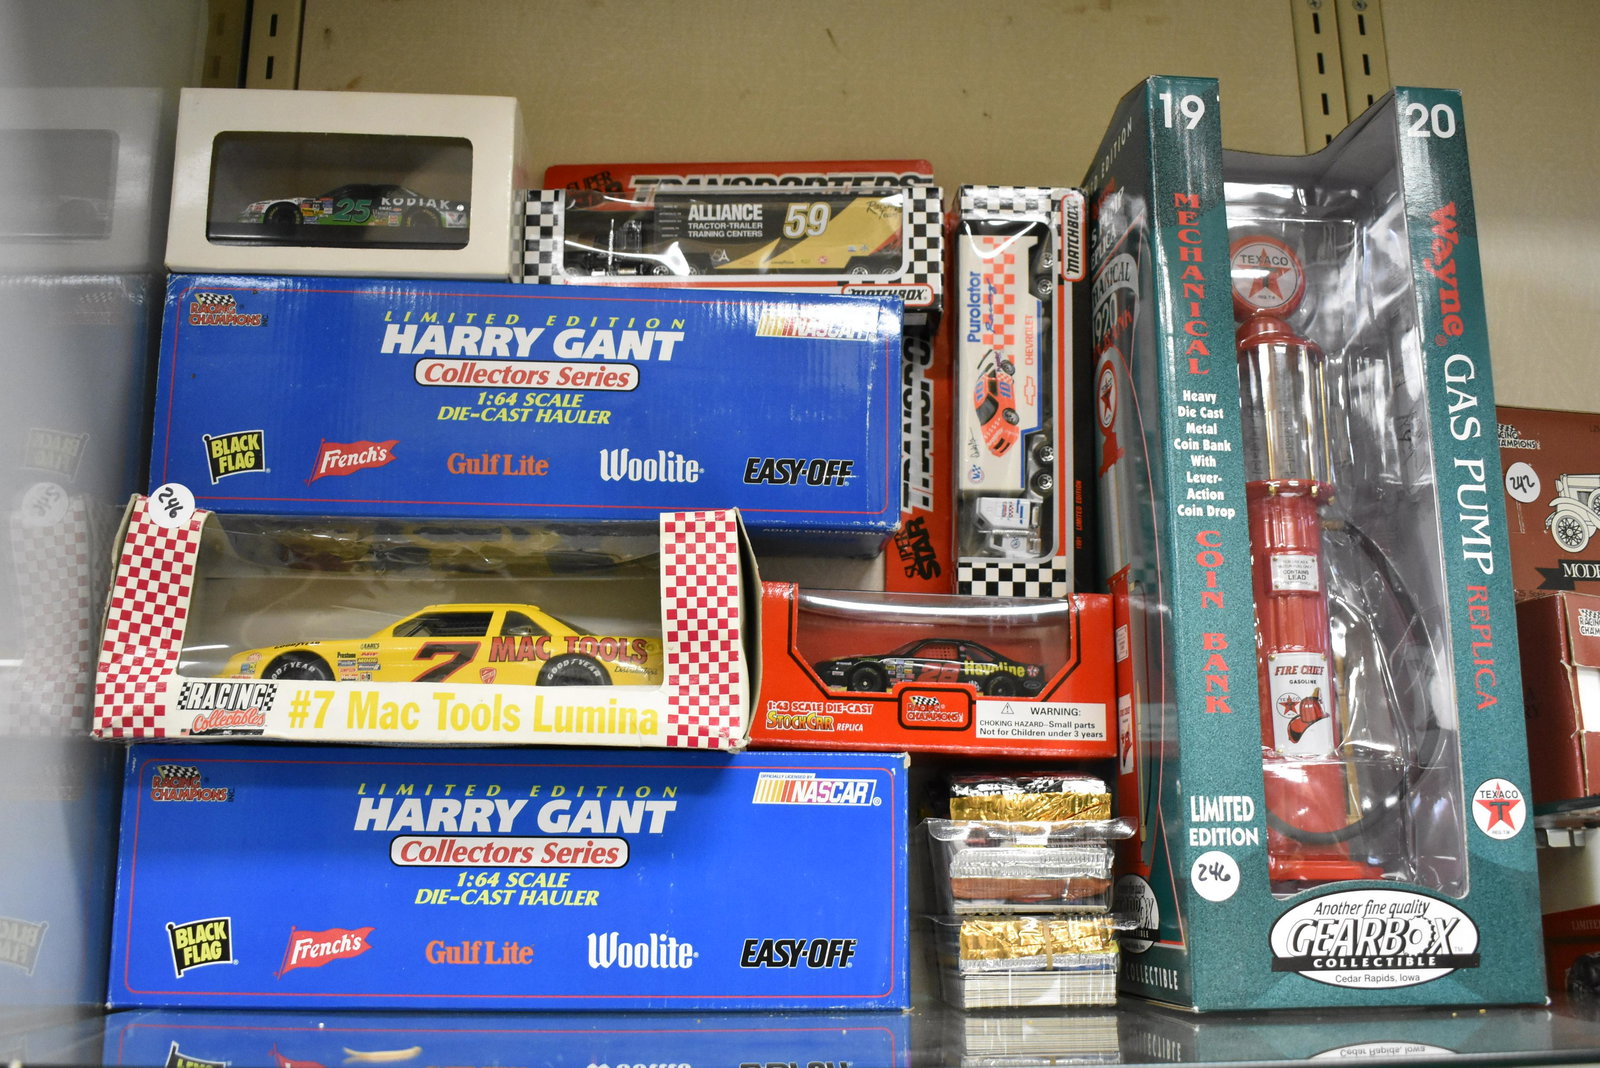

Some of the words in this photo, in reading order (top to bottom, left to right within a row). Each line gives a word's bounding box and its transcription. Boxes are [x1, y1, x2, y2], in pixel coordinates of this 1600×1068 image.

[1158, 92, 1206, 130] 19
[1404, 102, 1457, 139] 20
[333, 199, 372, 223] 25
[381, 196, 450, 210] KODIAK
[687, 203, 763, 221] ALLIANCE
[687, 222, 763, 230] TRACTOR-TRAILER
[783, 201, 832, 239] 59
[687, 230, 726, 238] TRAINING
[726, 230, 763, 238] CENTERS
[1066, 201, 1080, 274] MATCHBOX
[1240, 254, 1289, 266] TEXACO
[1423, 201, 1465, 337] Wayne
[1173, 192, 1211, 375] MECHANICAL
[190, 302, 237, 314] RACING
[967, 271, 982, 343] Purolator
[189, 313, 262, 326] CHAMPIONS
[384, 310, 520, 325] LIMITED
[546, 314, 687, 330] EDITION
[380, 323, 546, 357] HARRY
[553, 327, 685, 361] GANT
[1024, 315, 1034, 366] CHEVROLET
[424, 362, 550, 385] Collectors
[556, 366, 631, 388] Series
[477, 391, 517, 405] 1:64
[523, 393, 584, 408] SCALE
[1183, 390, 1217, 404] Heavy
[1444, 353, 1482, 441] GAS
[437, 406, 532, 422] DIE-CAST
[535, 409, 612, 424] HAULER
[1177, 406, 1197, 417] Die
[1200, 407, 1224, 419] Cast
[1186, 422, 1217, 435] Metal
[211, 433, 261, 460] BLACK
[1174, 438, 1200, 450] Coin
[1203, 439, 1231, 451] Bank
[1498, 439, 1538, 449] AMPIONS
[218, 450, 255, 474] FLAG
[319, 444, 388, 474] French's
[447, 453, 499, 475] Gulf
[507, 454, 549, 477] Lite
[599, 448, 700, 483] Woolite
[1191, 455, 1216, 467] With
[743, 457, 855, 487] EASY-OFF
[1186, 471, 1222, 484] Lever-
[157, 486, 185, 520] 246
[1187, 488, 1224, 501] Action
[1177, 504, 1203, 517] Coin
[1206, 506, 1235, 520] Drop
[1454, 457, 1494, 575] PUMP
[1195, 529, 1225, 609] COIN
[488, 636, 552, 663] MAC
[564, 635, 649, 665] TOOLS
[1466, 584, 1499, 711] REPLICA
[412, 640, 482, 683] 7
[1201, 632, 1232, 714] BANK
[1274, 665, 1299, 676] FIRE
[1300, 664, 1325, 676] CHIEF
[186, 683, 269, 711] RACING
[767, 700, 790, 712] 1:43
[791, 702, 823, 713] SCALE
[826, 702, 874, 715] DIE-CAST
[906, 703, 940, 712] RACING
[192, 707, 266, 733] Collectables
[288, 690, 336, 730] #7
[347, 691, 420, 731] Mac
[432, 692, 521, 732] Tools
[533, 694, 658, 735] Lumina
[906, 711, 959, 723] CHAMPIONS
[1030, 707, 1081, 717] WARNING:
[836, 722, 864, 732] REPLICA
[997, 728, 1009, 736] for
[1048, 729, 1072, 737] under
[1082, 731, 1104, 739] years
[1074, 721, 1095, 730] parts
[151, 776, 201, 788] RACING
[357, 782, 502, 797] LIMITED
[529, 784, 678, 798] EDITION
[790, 780, 869, 804] NASCAR
[150, 787, 228, 802] CHAMPIONS
[1479, 789, 1519, 800] TEXACO
[354, 797, 529, 832] HARRY
[537, 799, 677, 834] GANT
[1190, 795, 1255, 822] LIMITED
[1189, 827, 1259, 847] EDITION
[400, 838, 534, 864] Collectors
[540, 840, 620, 865] Series
[457, 871, 499, 887] 1:64
[505, 872, 570, 888] SCALE
[1197, 861, 1232, 882] 246
[414, 888, 512, 906] DIE-CAST
[518, 889, 600, 906] HAULER
[1313, 900, 1363, 917] Another
[1362, 899, 1388, 919] fine
[1389, 899, 1432, 919] quality
[175, 921, 228, 949] BLACK
[1285, 916, 1462, 957] GEARBOX
[183, 939, 223, 966] FLAG
[290, 932, 363, 965] French's
[425, 941, 483, 965] Gulf
[484, 942, 535, 966] Lite
[586, 931, 694, 969] Woolite
[740, 938, 857, 969] EASY-OFF
[1312, 956, 1438, 968] COLLECTIBLE
[1334, 973, 1362, 983] Cedar
[1363, 973, 1398, 985] Rapids,
[1399, 973, 1421, 982] Iowa
